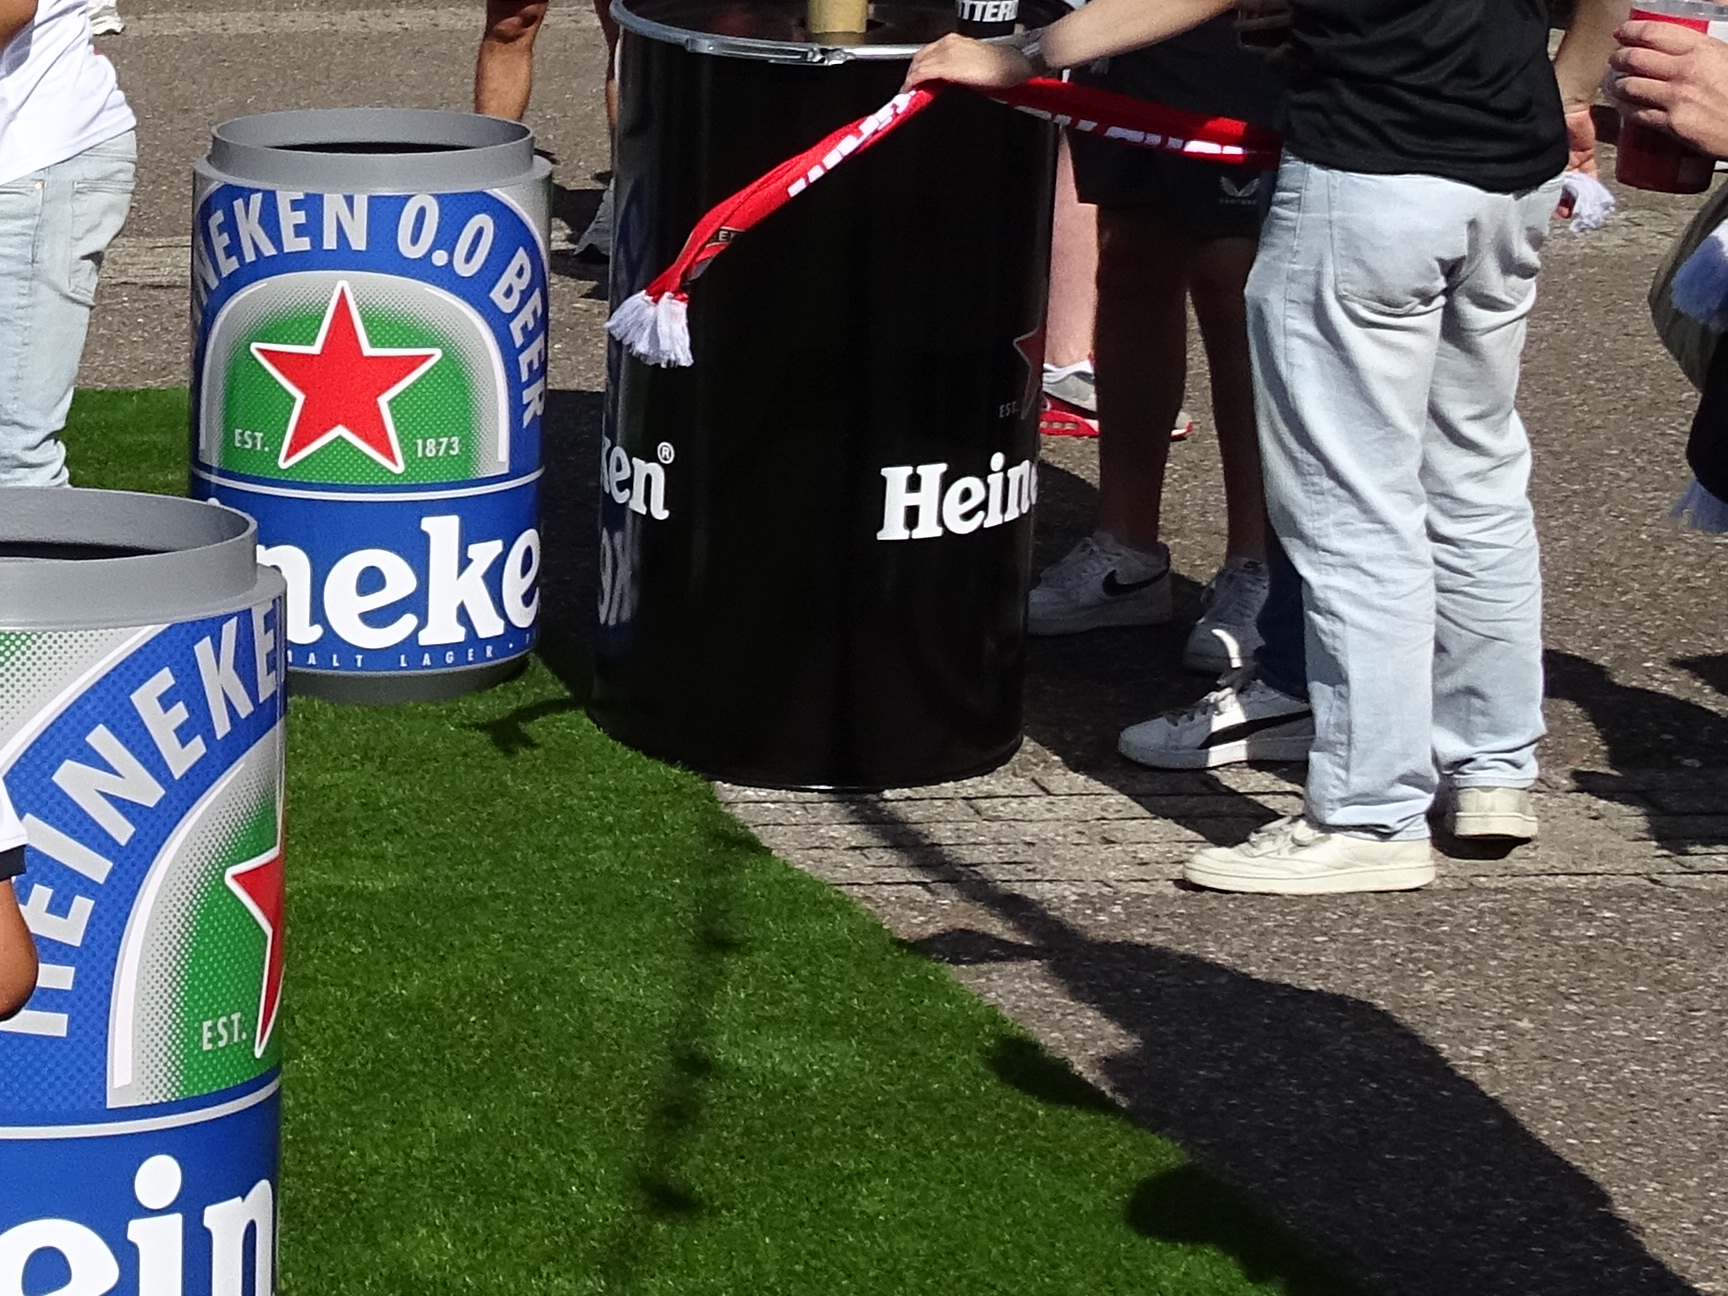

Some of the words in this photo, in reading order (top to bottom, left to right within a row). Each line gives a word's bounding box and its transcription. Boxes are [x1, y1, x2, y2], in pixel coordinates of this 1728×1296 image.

[398, 194, 494, 277] 0.0
[490, 246, 546, 427] BEER
[234, 429, 269, 452] EST.
[416, 436, 460, 458] 1873
[400, 644, 493, 666] LAGER
[203, 1013, 248, 1051] EST.
